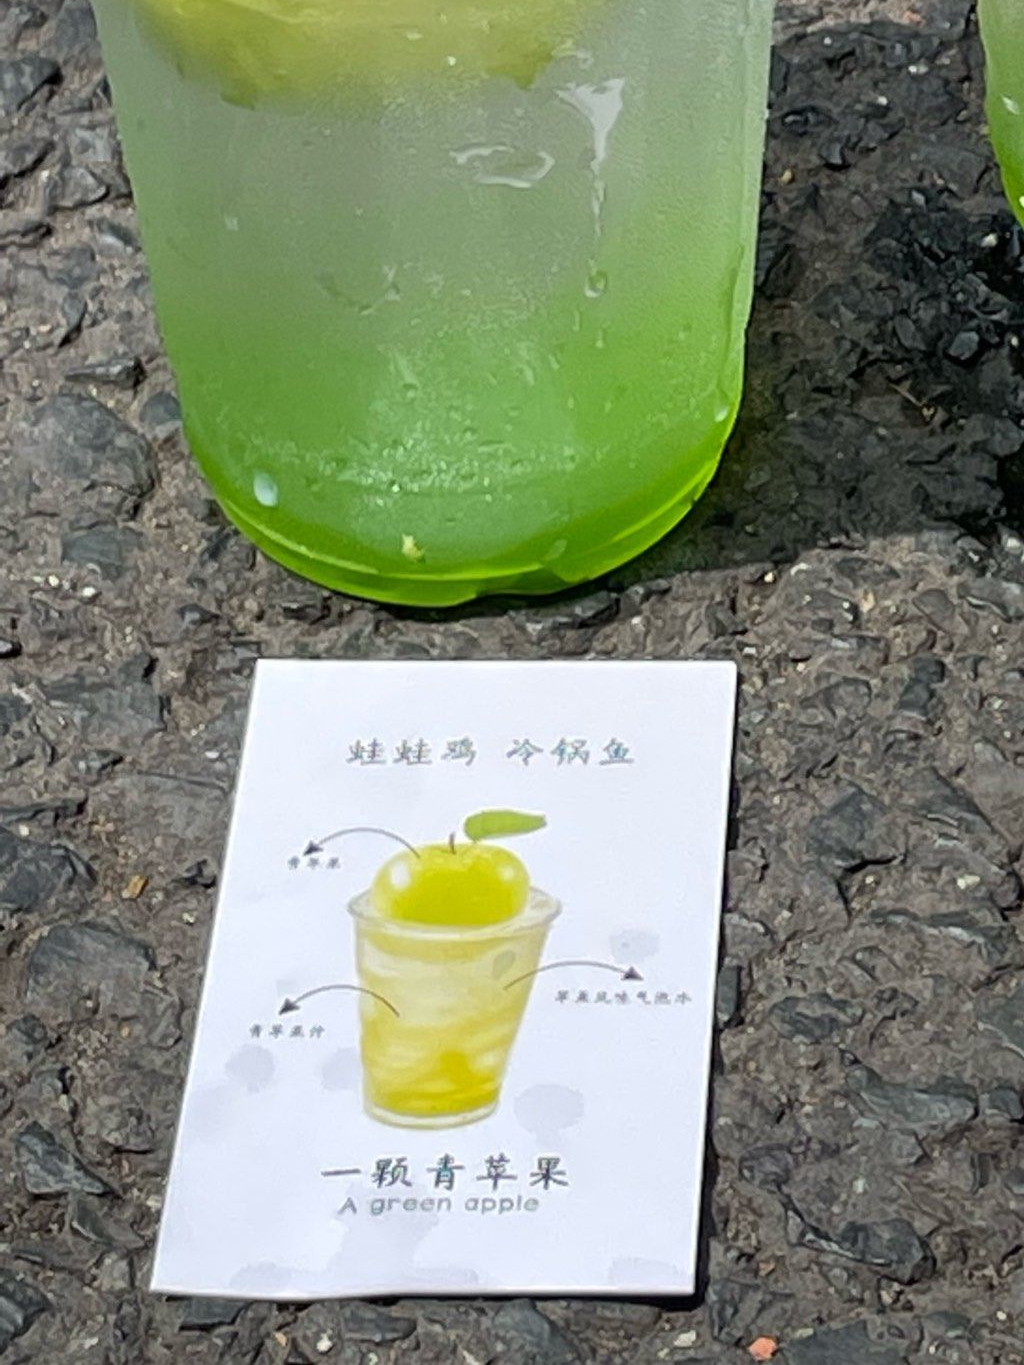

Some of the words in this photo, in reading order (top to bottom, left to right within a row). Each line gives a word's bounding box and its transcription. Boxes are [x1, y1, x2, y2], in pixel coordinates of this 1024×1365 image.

[346, 737, 476, 767] 蛙蛙鸡
[506, 738, 635, 767] 冷锅鱼
[321, 1152, 569, 1191] 一颗青苹果
[338, 1197, 358, 1215] A
[370, 1197, 452, 1216] green
[465, 1194, 540, 1215] apple
